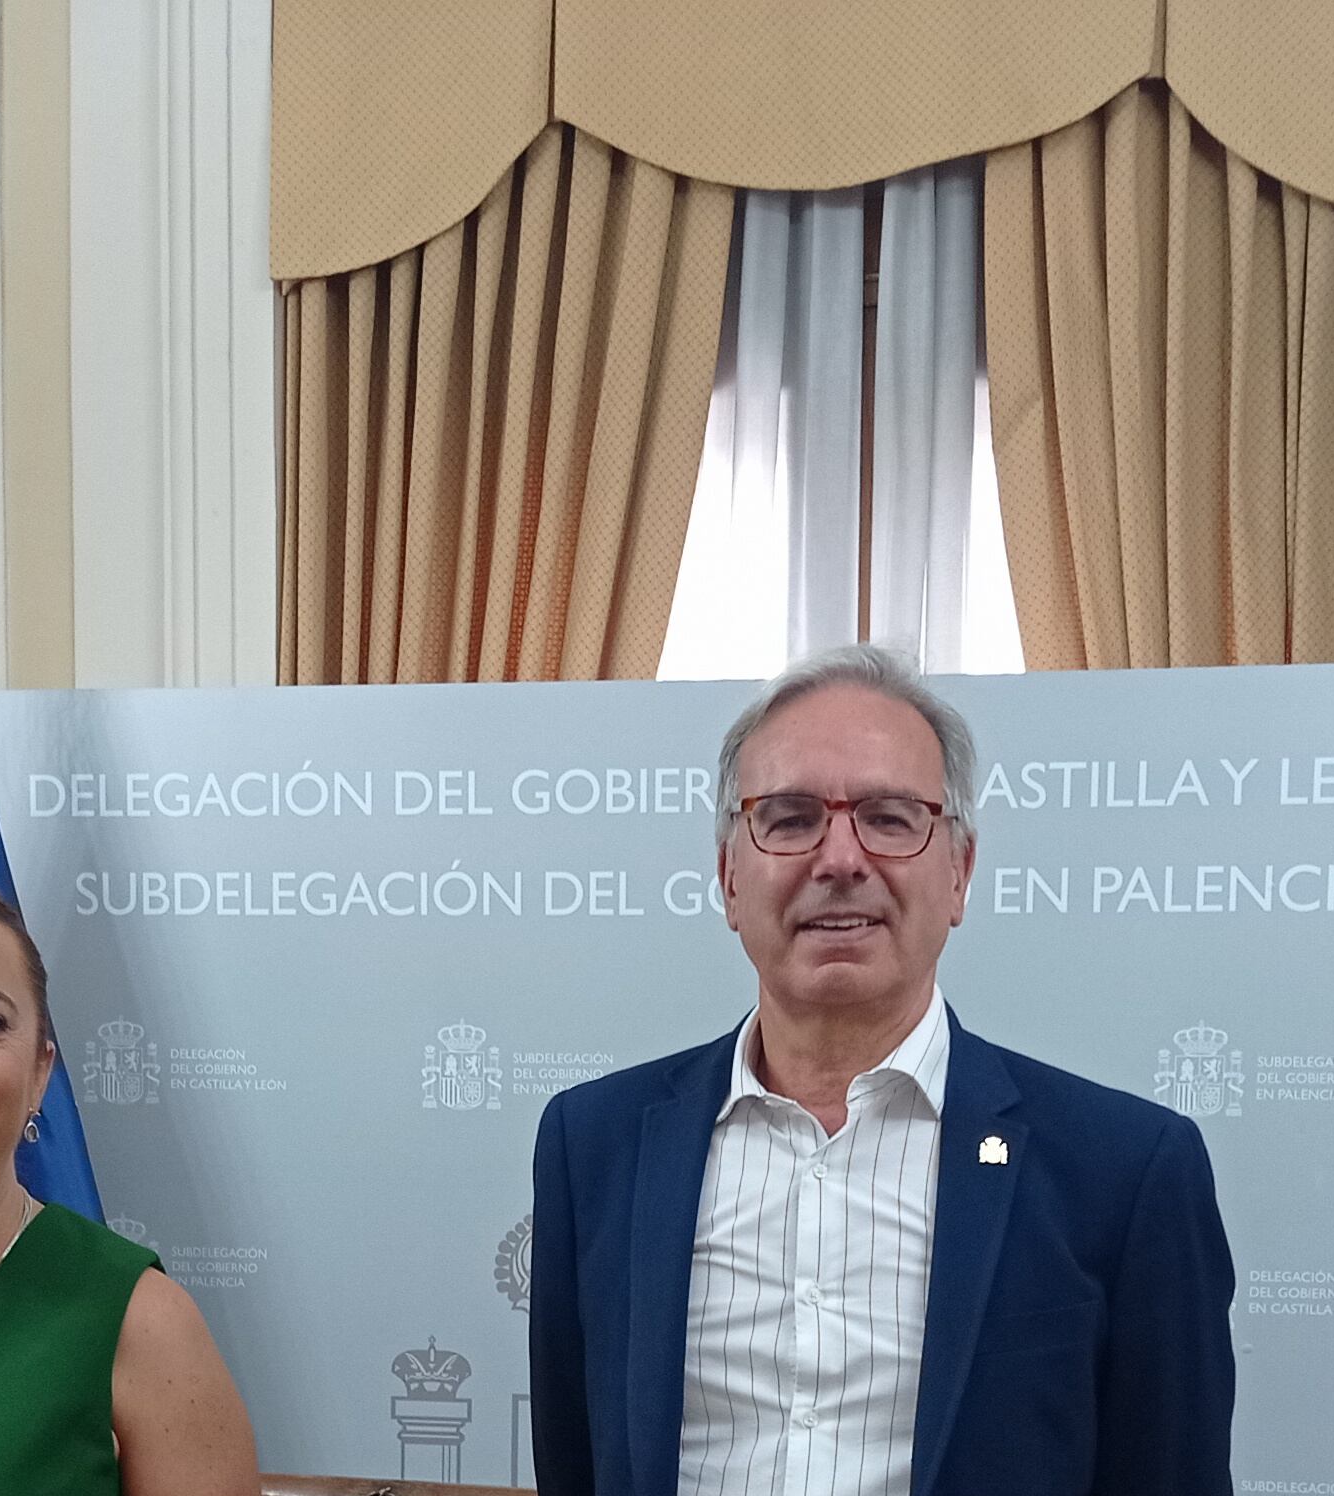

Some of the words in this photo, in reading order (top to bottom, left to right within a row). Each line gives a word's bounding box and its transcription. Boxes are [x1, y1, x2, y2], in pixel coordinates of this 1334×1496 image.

[28, 759, 372, 818] DELEGACIÓN
[394, 769, 493, 817] DEL
[511, 766, 717, 815] GOBIER
[976, 759, 1210, 809] ASTILLA
[1219, 758, 1259, 806] Y
[75, 859, 522, 917] SUBDELEGACIÓN
[544, 870, 644, 917] DEL
[993, 866, 1069, 914] EN
[170, 1047, 246, 1060] DELEGACIÓN
[513, 1051, 613, 1064] SUBDELEGACIÓN
[170, 1063, 192, 1074] DEL
[195, 1063, 258, 1076] GOBIERNO
[513, 1067, 534, 1079] DEL
[538, 1068, 604, 1080] GOBIERNO
[170, 1078, 186, 1089] EN
[189, 1078, 243, 1091] CASTILLA
[243, 1079, 252, 1090] Y
[254, 1077, 287, 1091] LEÓN
[1257, 1072, 1282, 1084] DEL
[513, 1083, 529, 1095] EN
[1255, 1088, 1274, 1101] EN
[171, 1246, 268, 1260] SUBDELEGACIÓN
[172, 1262, 193, 1273] DEL
[196, 1262, 259, 1274] GOBIERNO
[190, 1276, 246, 1288] PALENCIA
[1249, 1286, 1274, 1299] DEL
[1248, 1303, 1267, 1315] EN
[1270, 1303, 1333, 1316] CASTILLA
